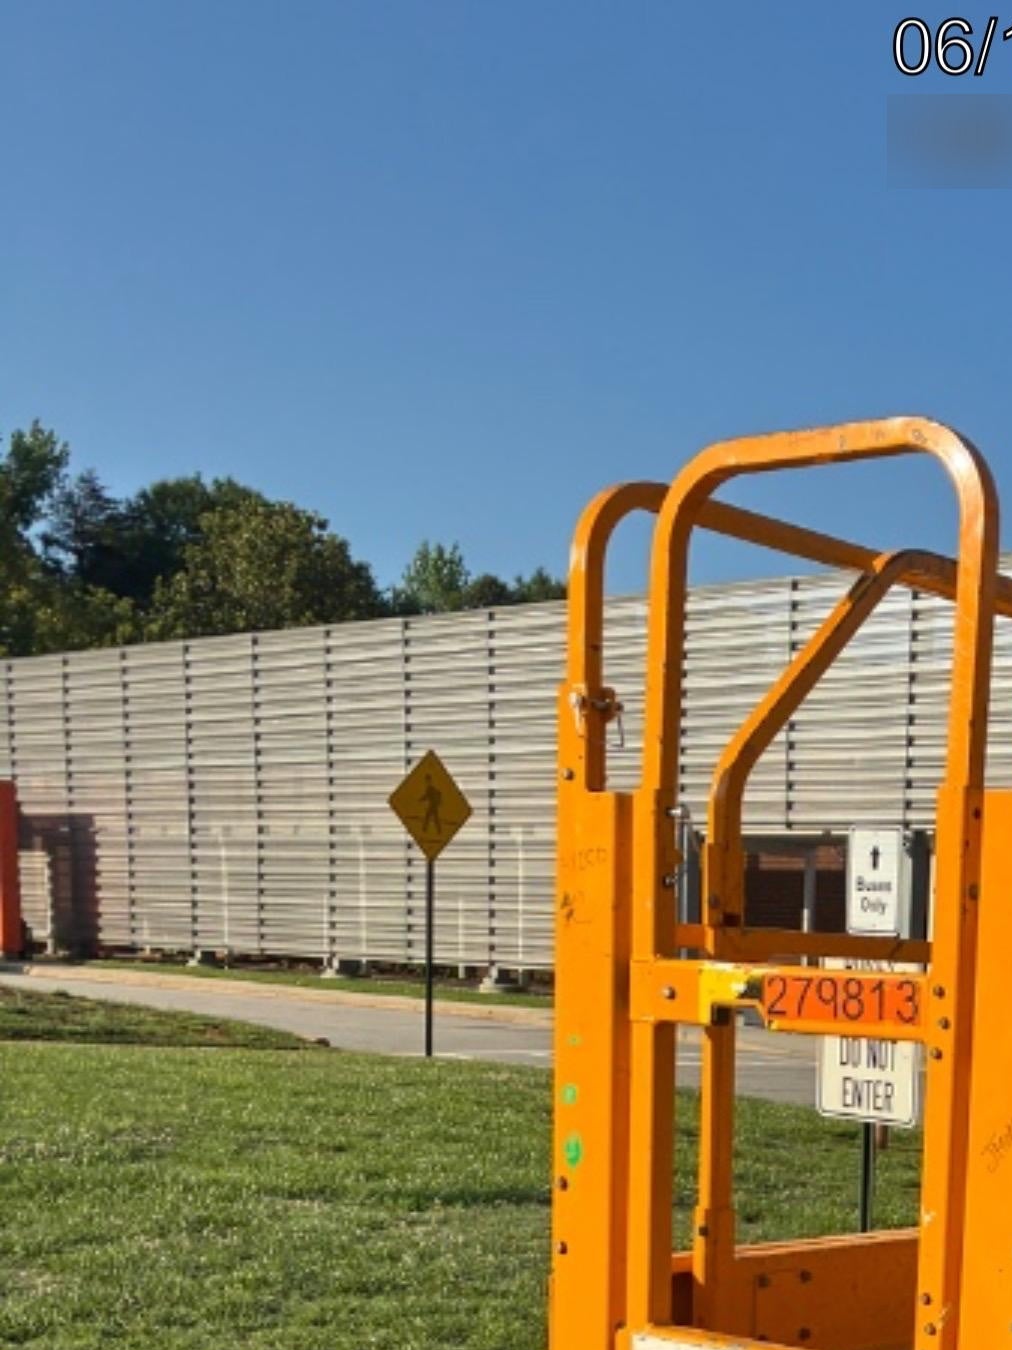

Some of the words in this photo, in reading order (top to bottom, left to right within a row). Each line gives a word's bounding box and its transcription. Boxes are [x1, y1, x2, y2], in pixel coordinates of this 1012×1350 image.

[856, 875, 892, 892] Buses
[860, 896, 888, 915] Only
[767, 975, 919, 1024] 279813
[840, 1036, 861, 1067] DO
[866, 1038, 896, 1071] NOT
[842, 1076, 894, 1112] ENTER
